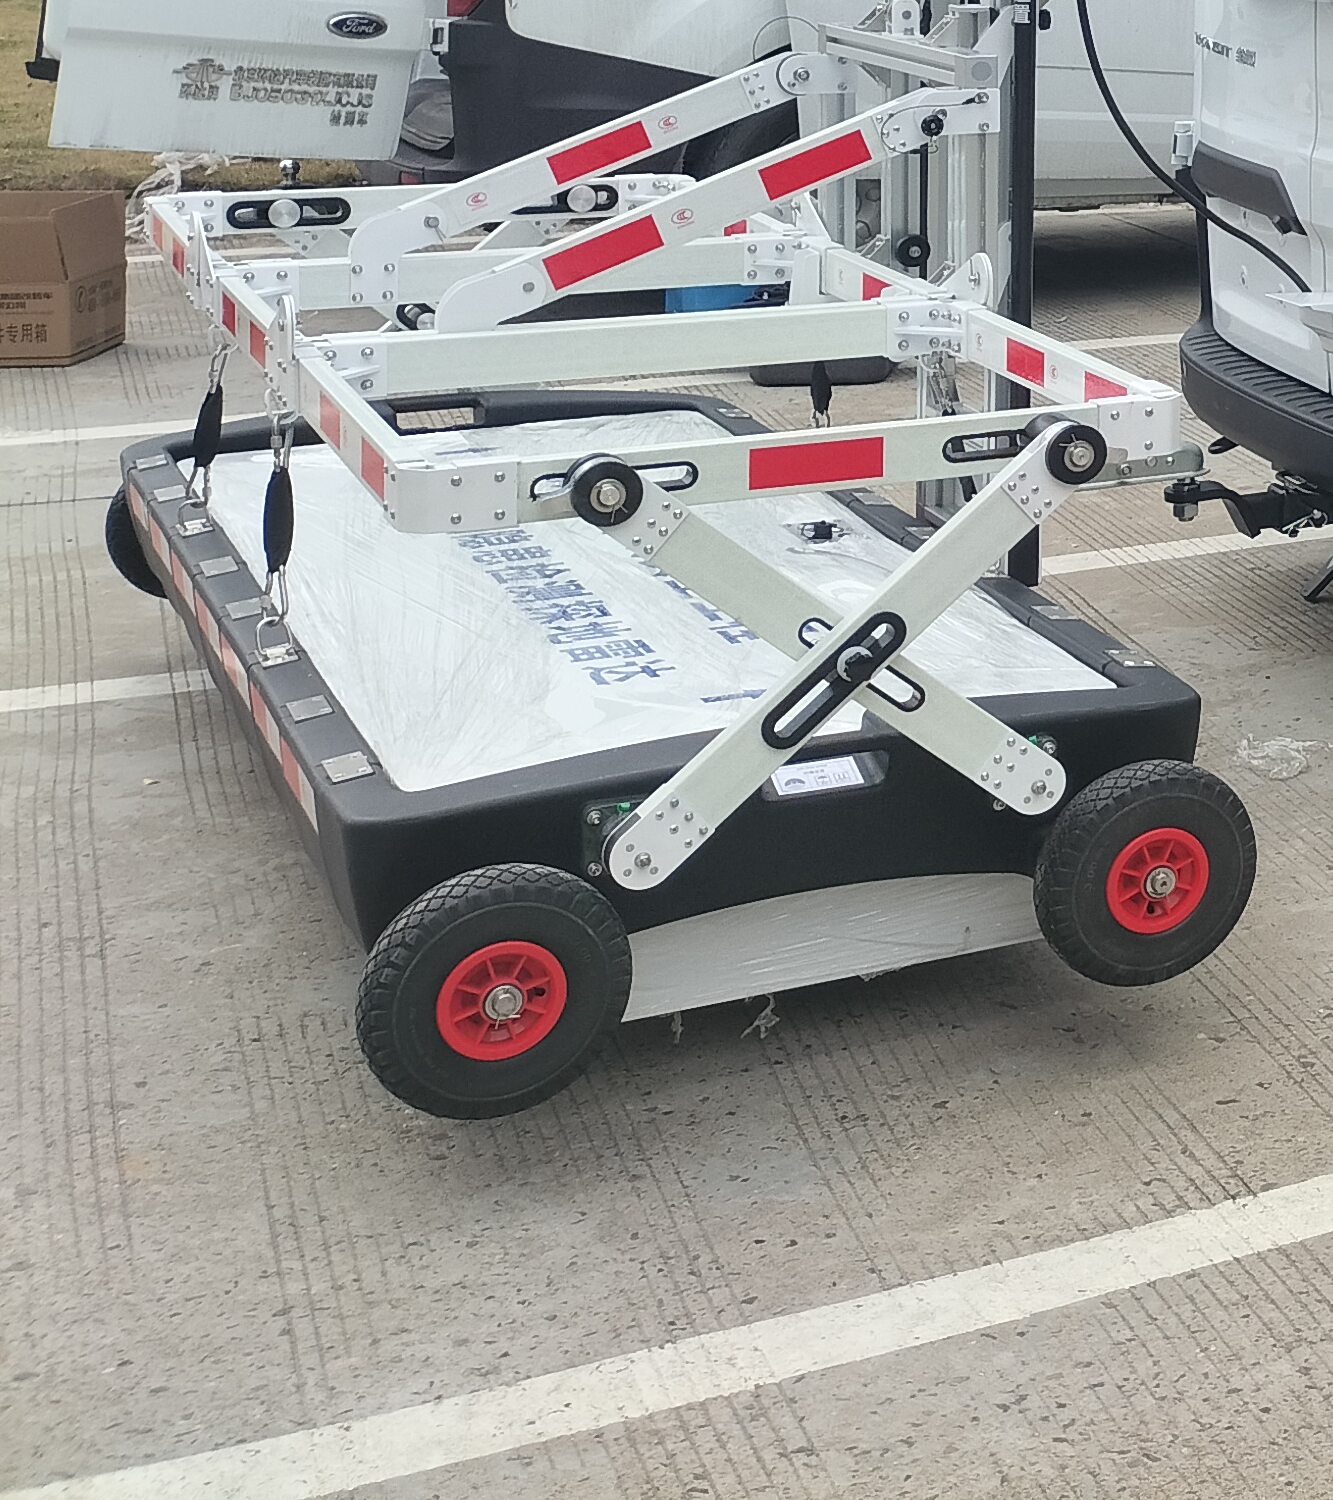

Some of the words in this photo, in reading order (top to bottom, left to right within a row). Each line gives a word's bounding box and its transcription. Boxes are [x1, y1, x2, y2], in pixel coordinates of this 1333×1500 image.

[449, 528, 677, 687] 隐患检测探地雷达
